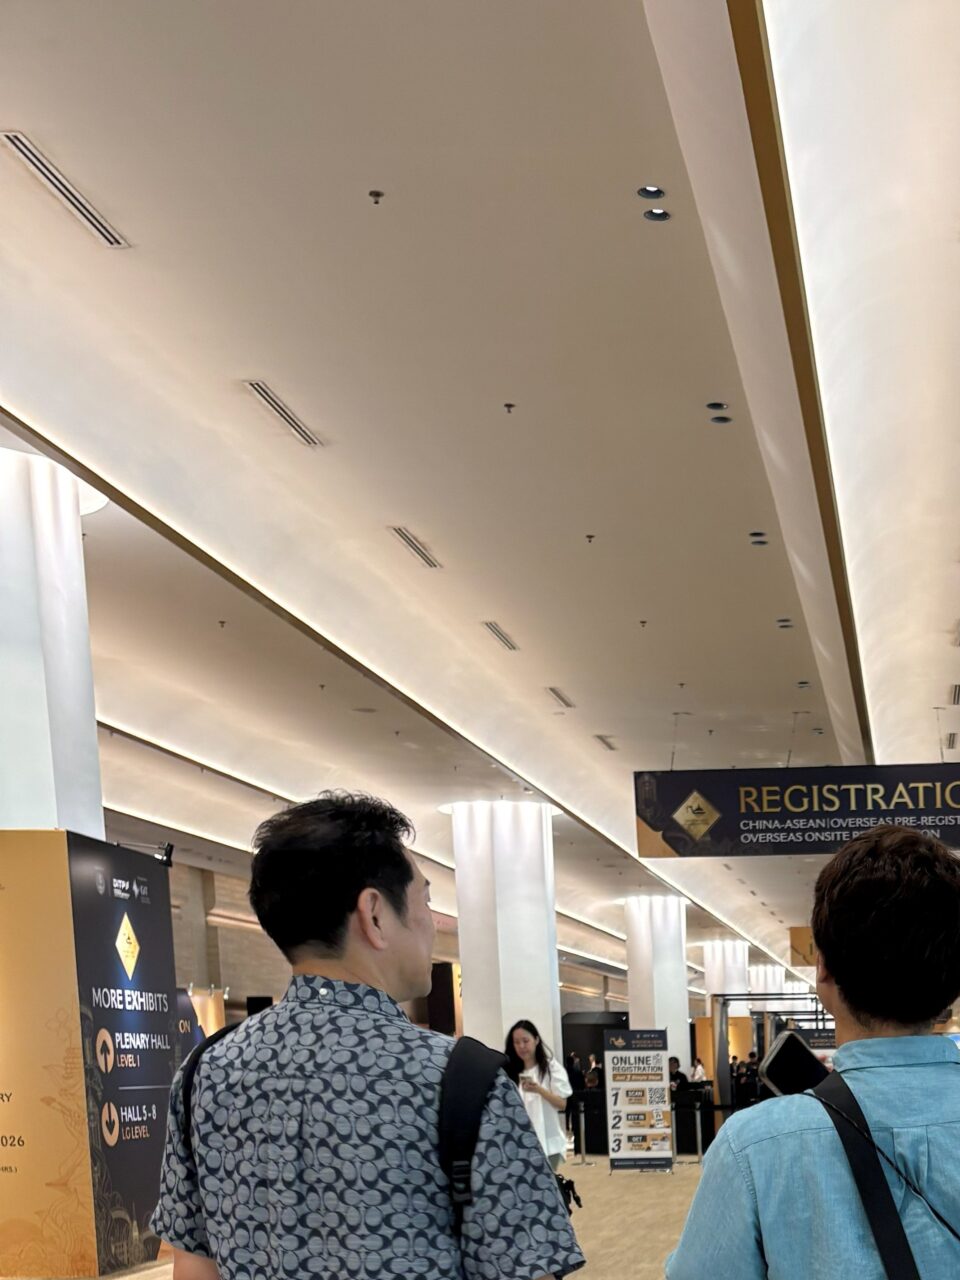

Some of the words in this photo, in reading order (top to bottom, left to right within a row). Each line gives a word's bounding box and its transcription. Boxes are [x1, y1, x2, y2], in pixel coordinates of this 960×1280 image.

[740, 832, 803, 843] OVERSEAS
[804, 831, 850, 842] ONSITE
[92, 987, 124, 1010] MORE
[124, 989, 169, 1013] EXHIBITS
[115, 1032, 150, 1050] PLENARY
[150, 1034, 171, 1050] HALL
[116, 1054, 136, 1067] LEVEL
[611, 1055, 652, 1066] ONLINE
[611, 1091, 619, 1107] 1
[120, 1105, 142, 1122] HALL
[142, 1105, 148, 1121] 5
[152, 1103, 157, 1120] 8
[611, 1115, 623, 1130] 2
[122, 1126, 131, 1140] LG
[131, 1125, 150, 1139] LEVEL
[611, 1138, 622, 1153] 3
